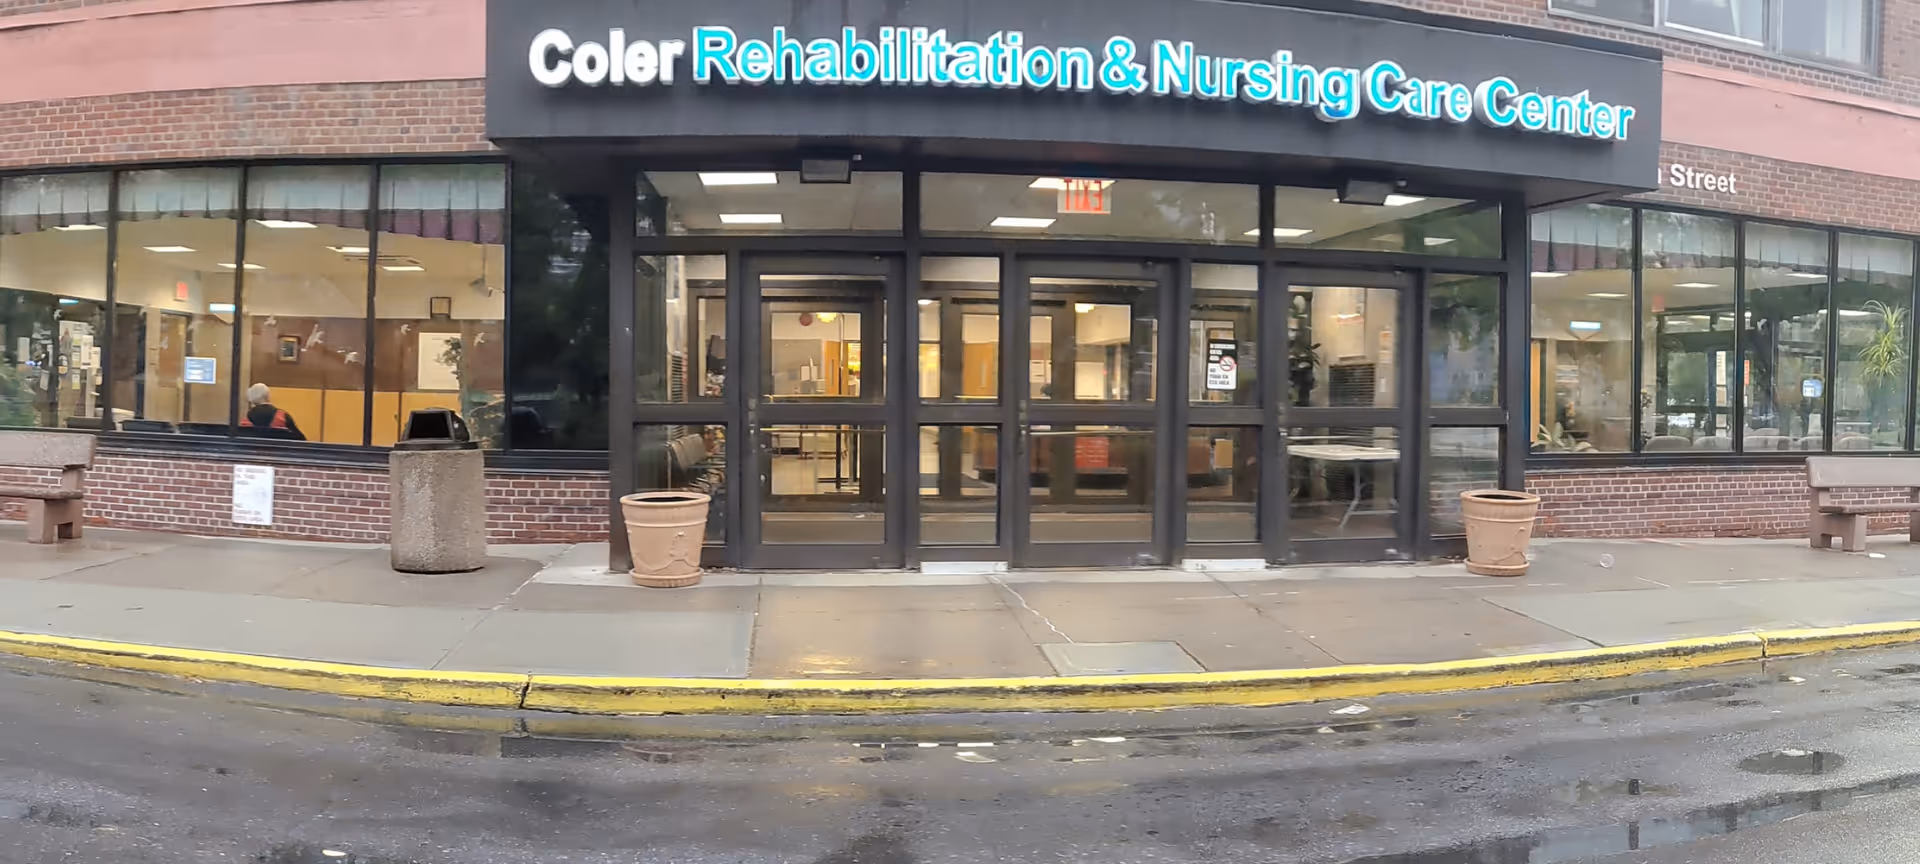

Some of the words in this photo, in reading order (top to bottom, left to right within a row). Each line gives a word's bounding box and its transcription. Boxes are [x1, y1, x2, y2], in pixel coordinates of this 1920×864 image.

[529, 28, 684, 86] Coler
[693, 26, 1093, 91] Rehabilitation
[1099, 35, 1147, 96] &
[1152, 38, 1361, 122] Nursing
[1363, 60, 1474, 123] Care
[1475, 76, 1636, 142] Center
[1669, 163, 1737, 194] Street
